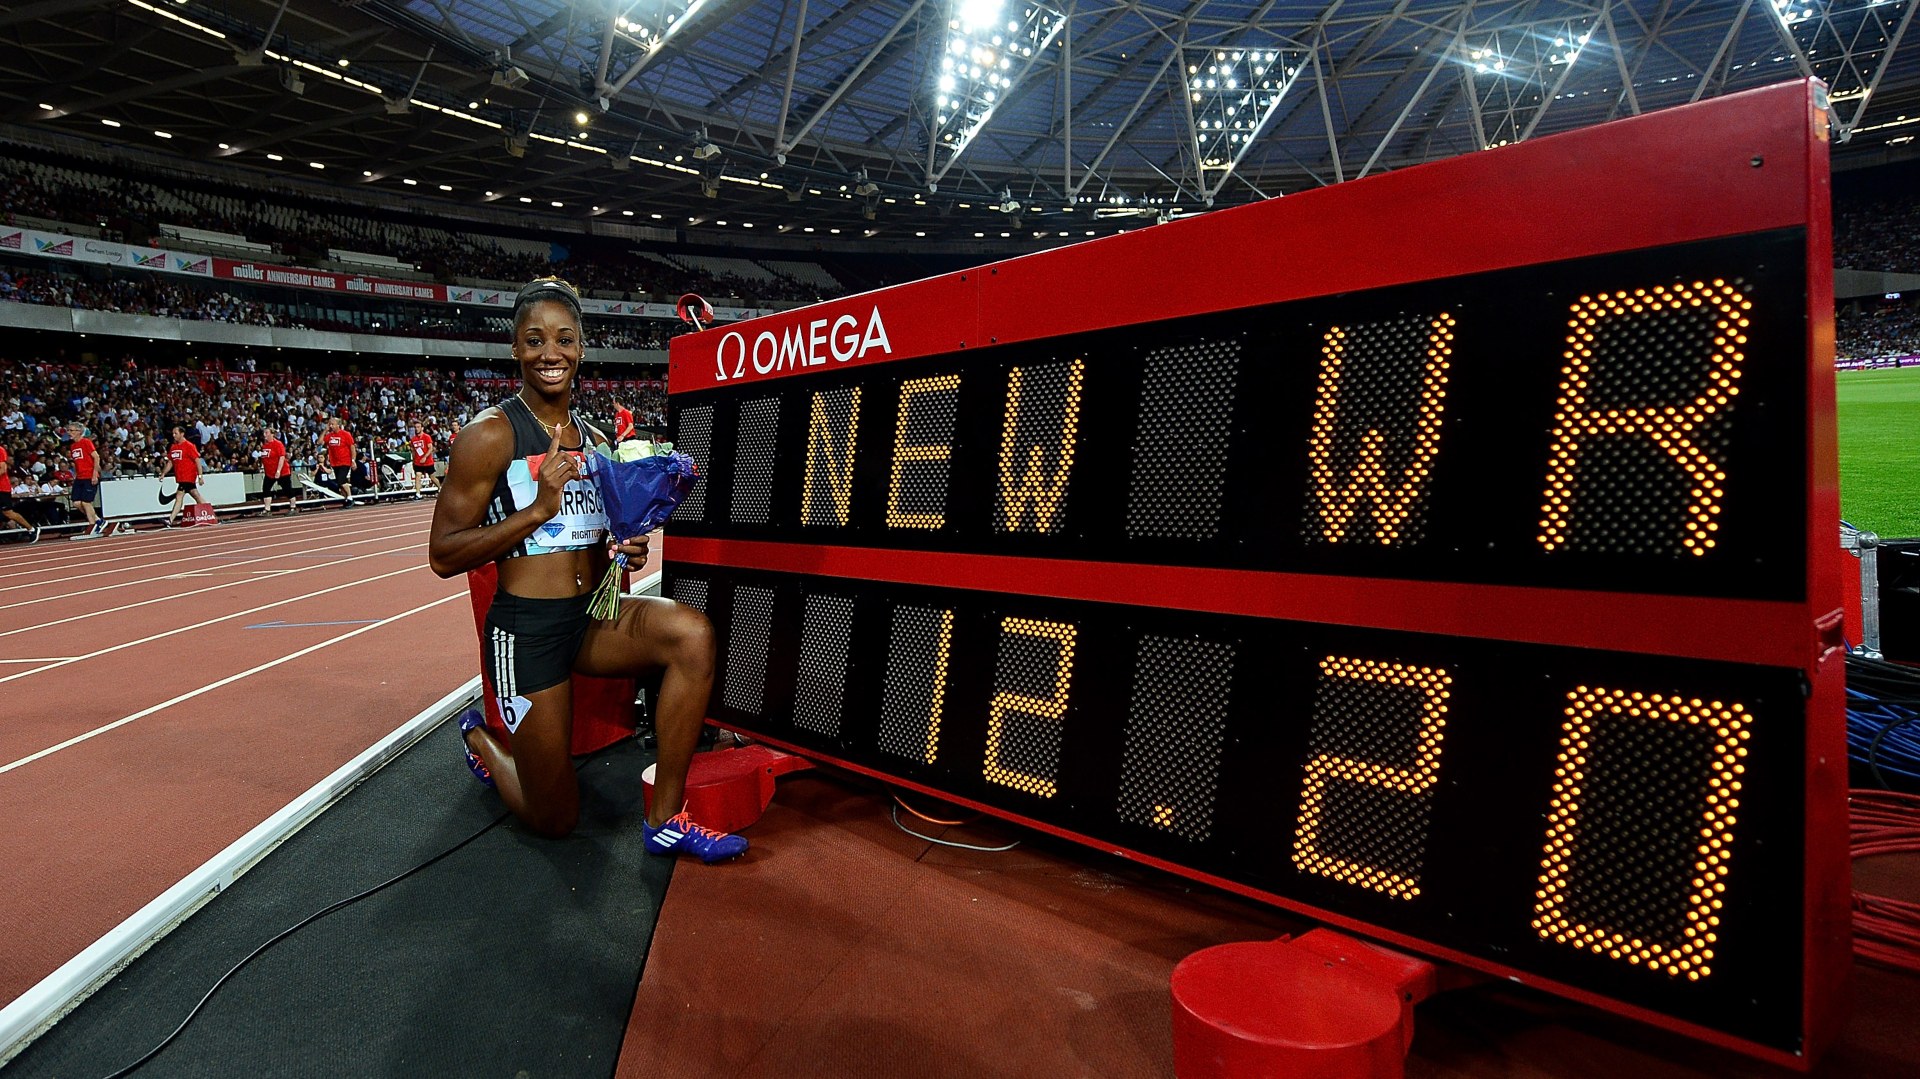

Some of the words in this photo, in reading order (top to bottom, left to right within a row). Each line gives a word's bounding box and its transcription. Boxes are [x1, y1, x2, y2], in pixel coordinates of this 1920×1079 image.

[233, 264, 264, 280] müller
[266, 270, 312, 286] ANNIVERSARY
[312, 275, 336, 289] GAMES
[374, 283, 414, 296] ANNIVERSARY
[414, 287, 434, 299] GAMES
[752, 304, 892, 375] OMEGA
[800, 358, 1085, 532] NEW
[560, 490, 604, 516] RRISO
[501, 697, 517, 725] 6
[925, 609, 1753, 981] 12.20
